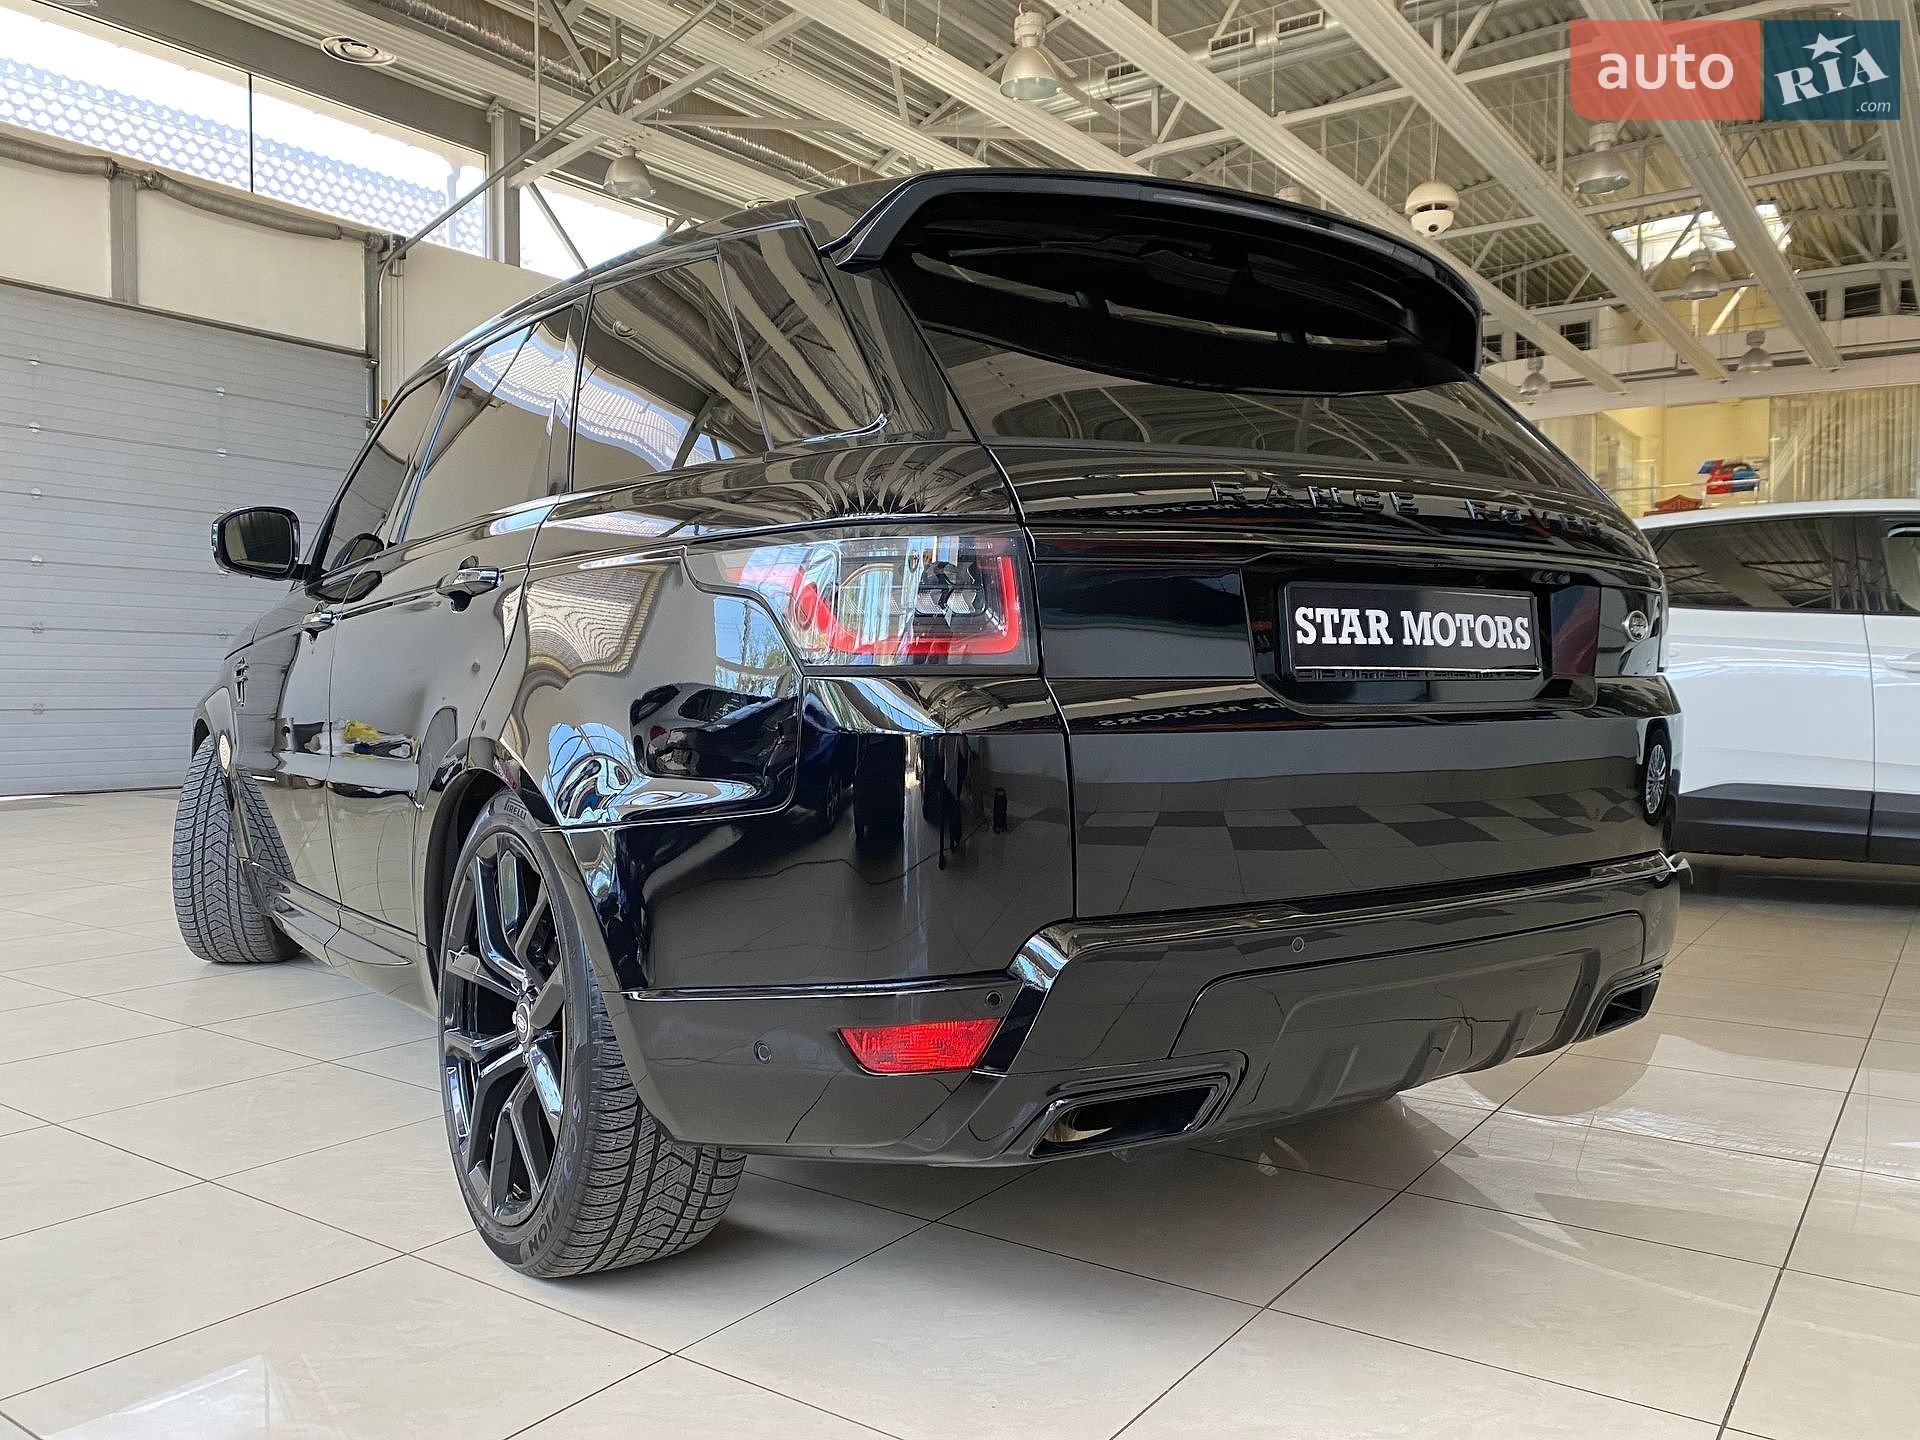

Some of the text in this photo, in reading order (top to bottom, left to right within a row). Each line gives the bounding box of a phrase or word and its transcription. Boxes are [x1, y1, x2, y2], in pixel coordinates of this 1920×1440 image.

[1211, 480, 1419, 515] RANGE
[1295, 607, 1531, 650] STAR MOTORS
[504, 797, 528, 820] PIRELLI
